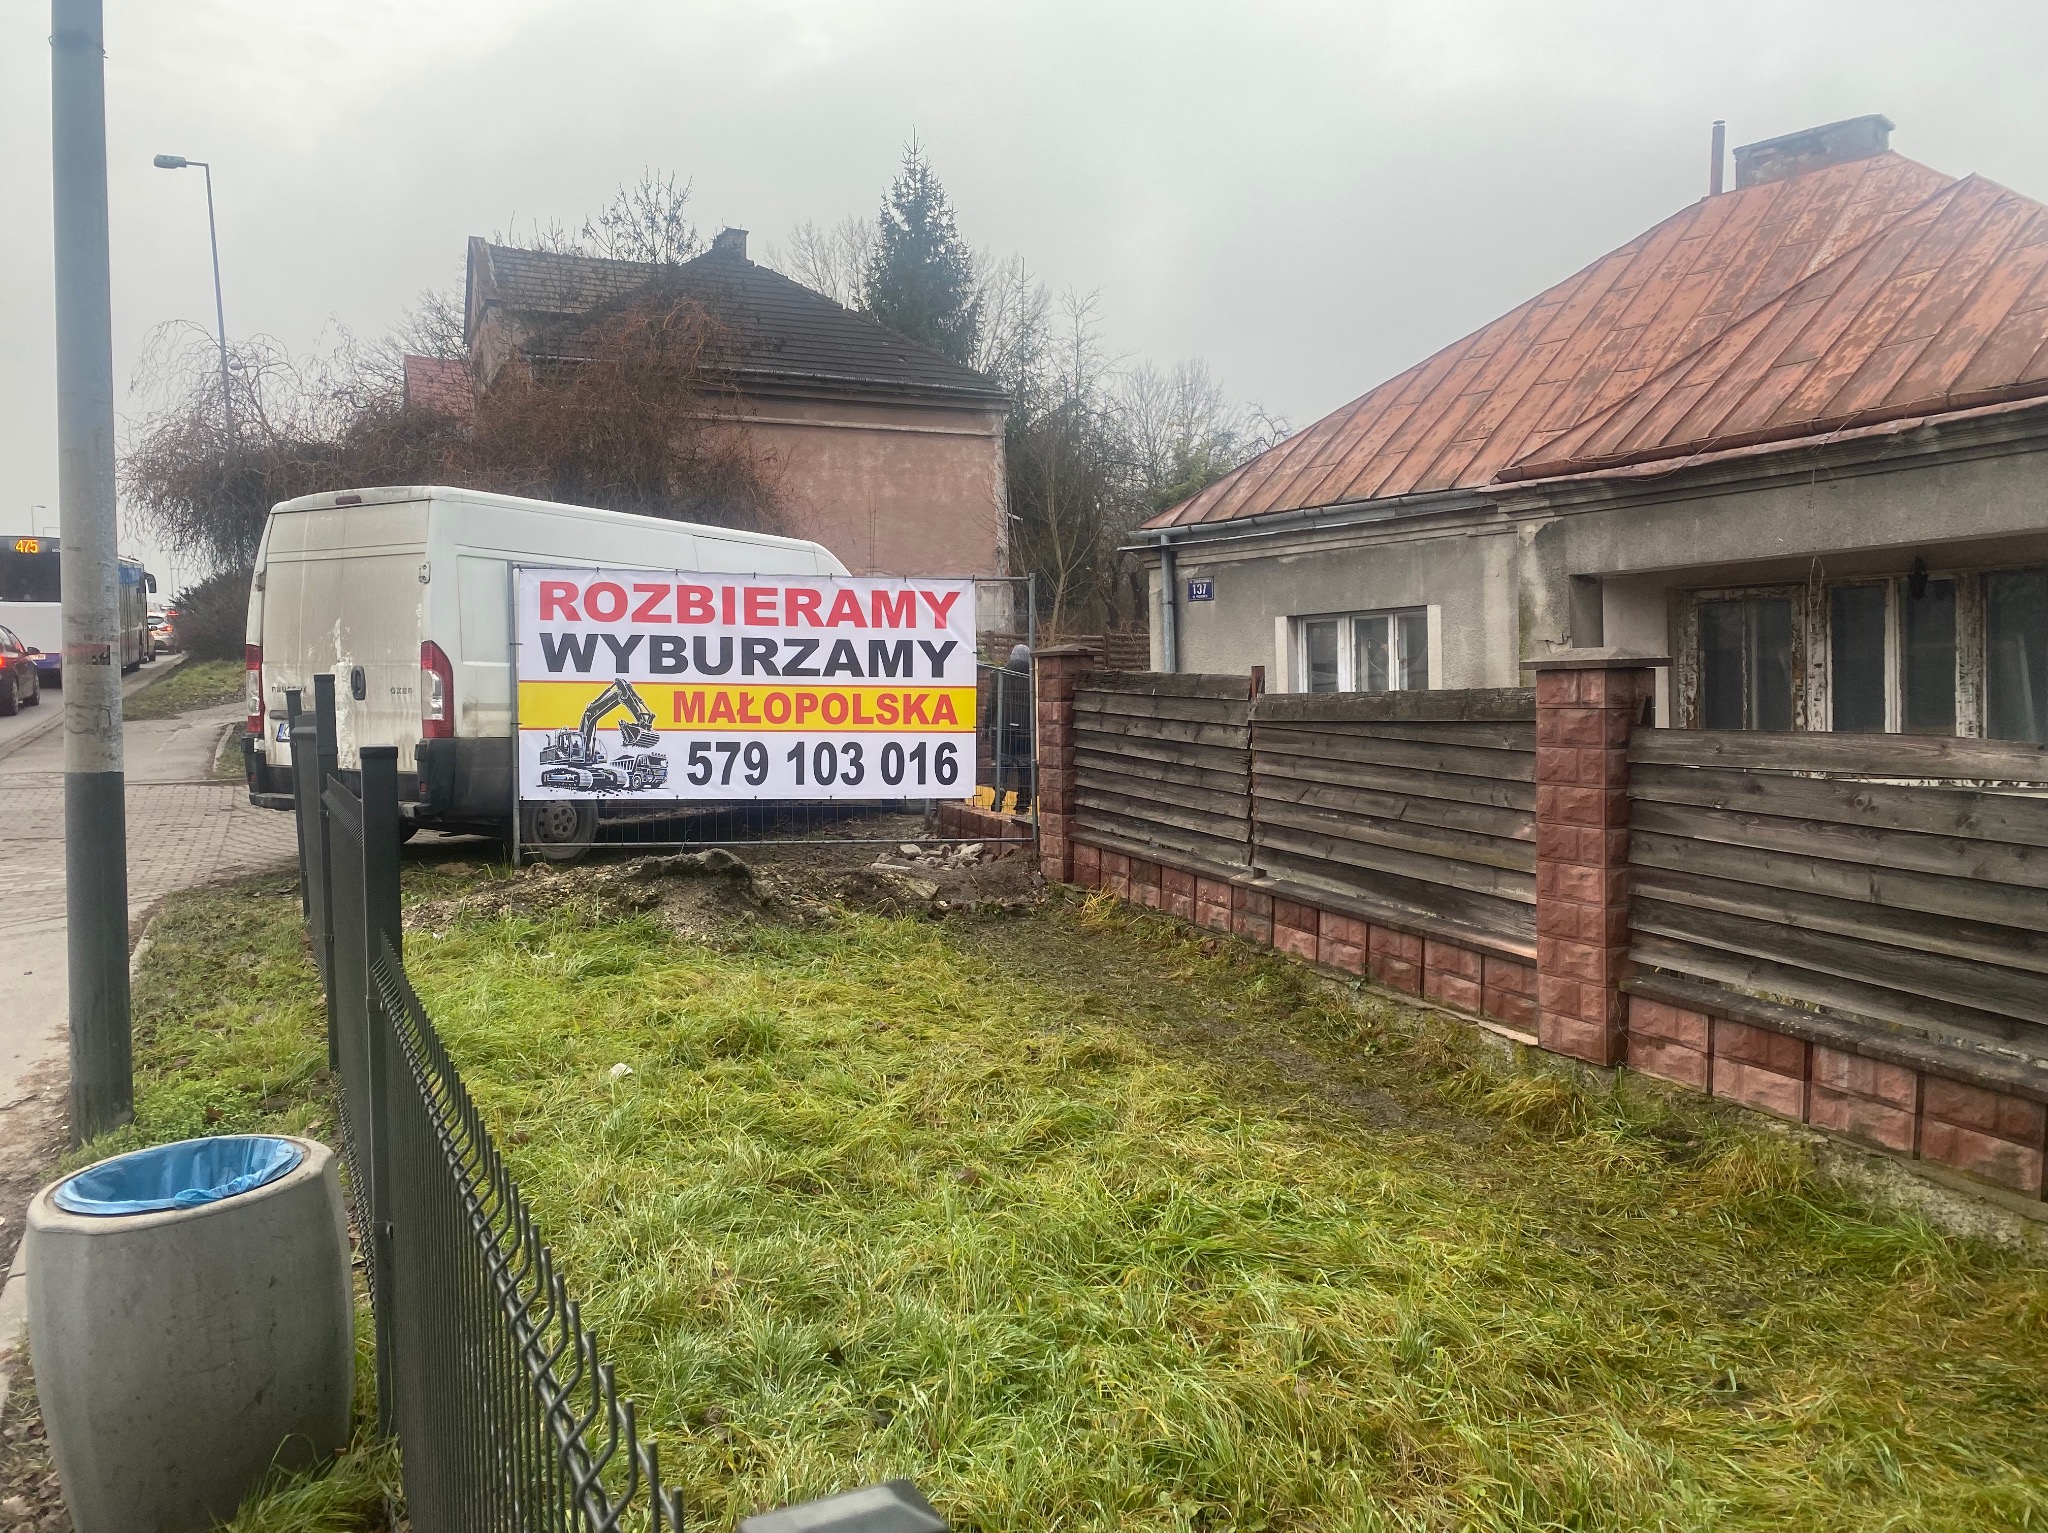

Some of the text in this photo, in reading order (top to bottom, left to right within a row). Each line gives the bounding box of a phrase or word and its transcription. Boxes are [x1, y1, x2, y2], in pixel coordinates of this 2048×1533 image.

[15, 539, 39, 553] 475
[540, 581, 961, 629] ROZBIERAMY
[1192, 584, 1207, 595] 137
[539, 632, 959, 678] WYBURZAMY
[673, 690, 958, 725] MAŁOPOLSKA
[687, 741, 958, 786] 579 103 016
